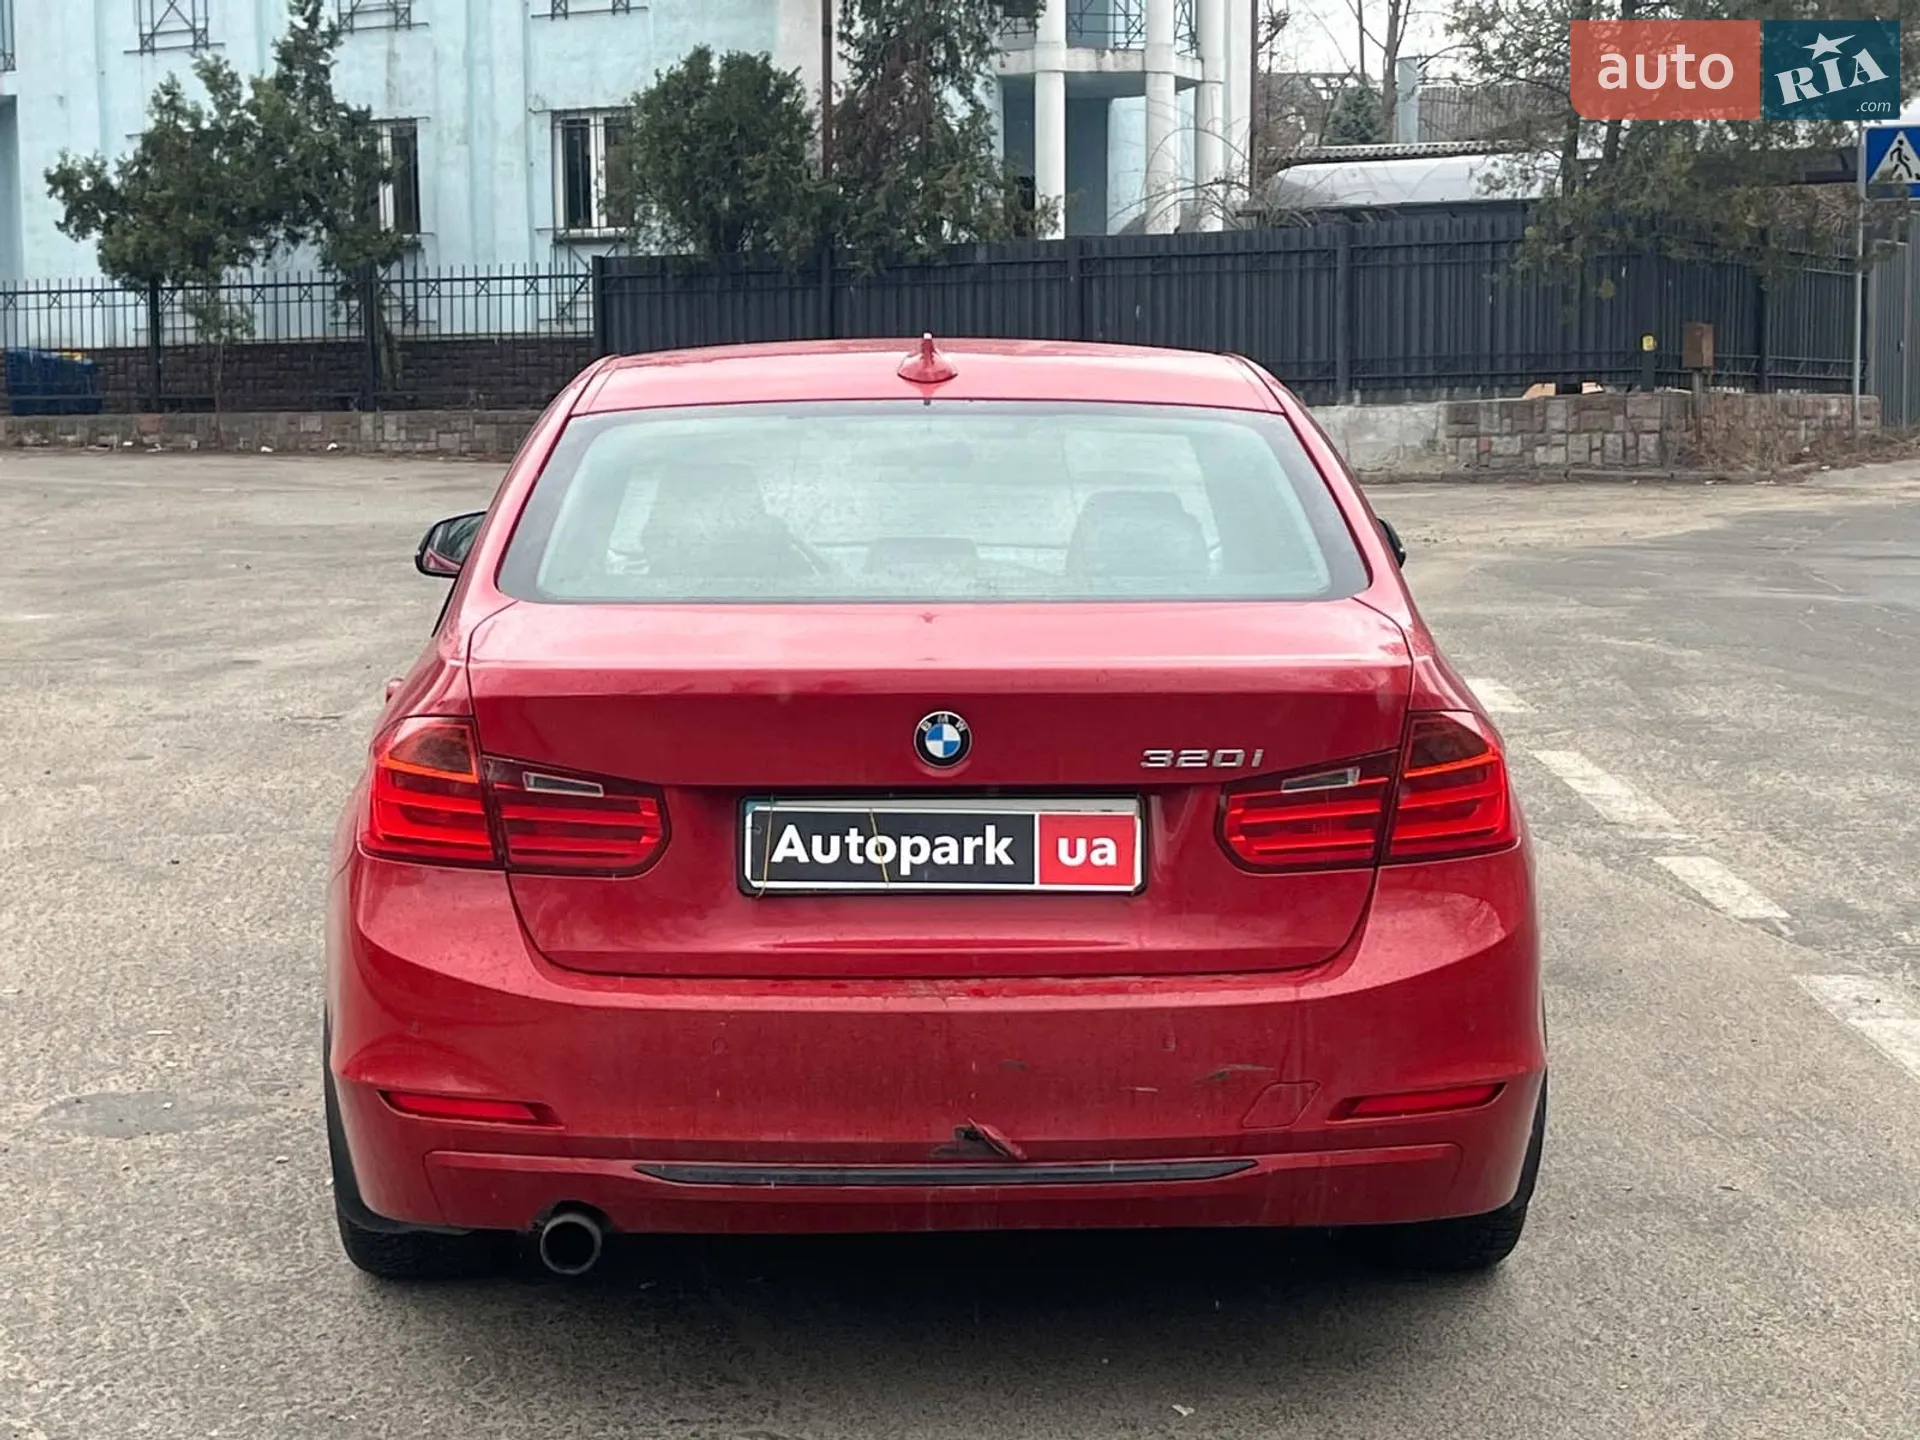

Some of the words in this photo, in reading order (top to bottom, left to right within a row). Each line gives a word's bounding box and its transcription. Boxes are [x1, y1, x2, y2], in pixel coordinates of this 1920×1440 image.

[920, 714, 968, 732] BMW
[1140, 748, 1265, 768] 320i
[770, 824, 1015, 876] Autopark
[1057, 836, 1118, 867] ua
